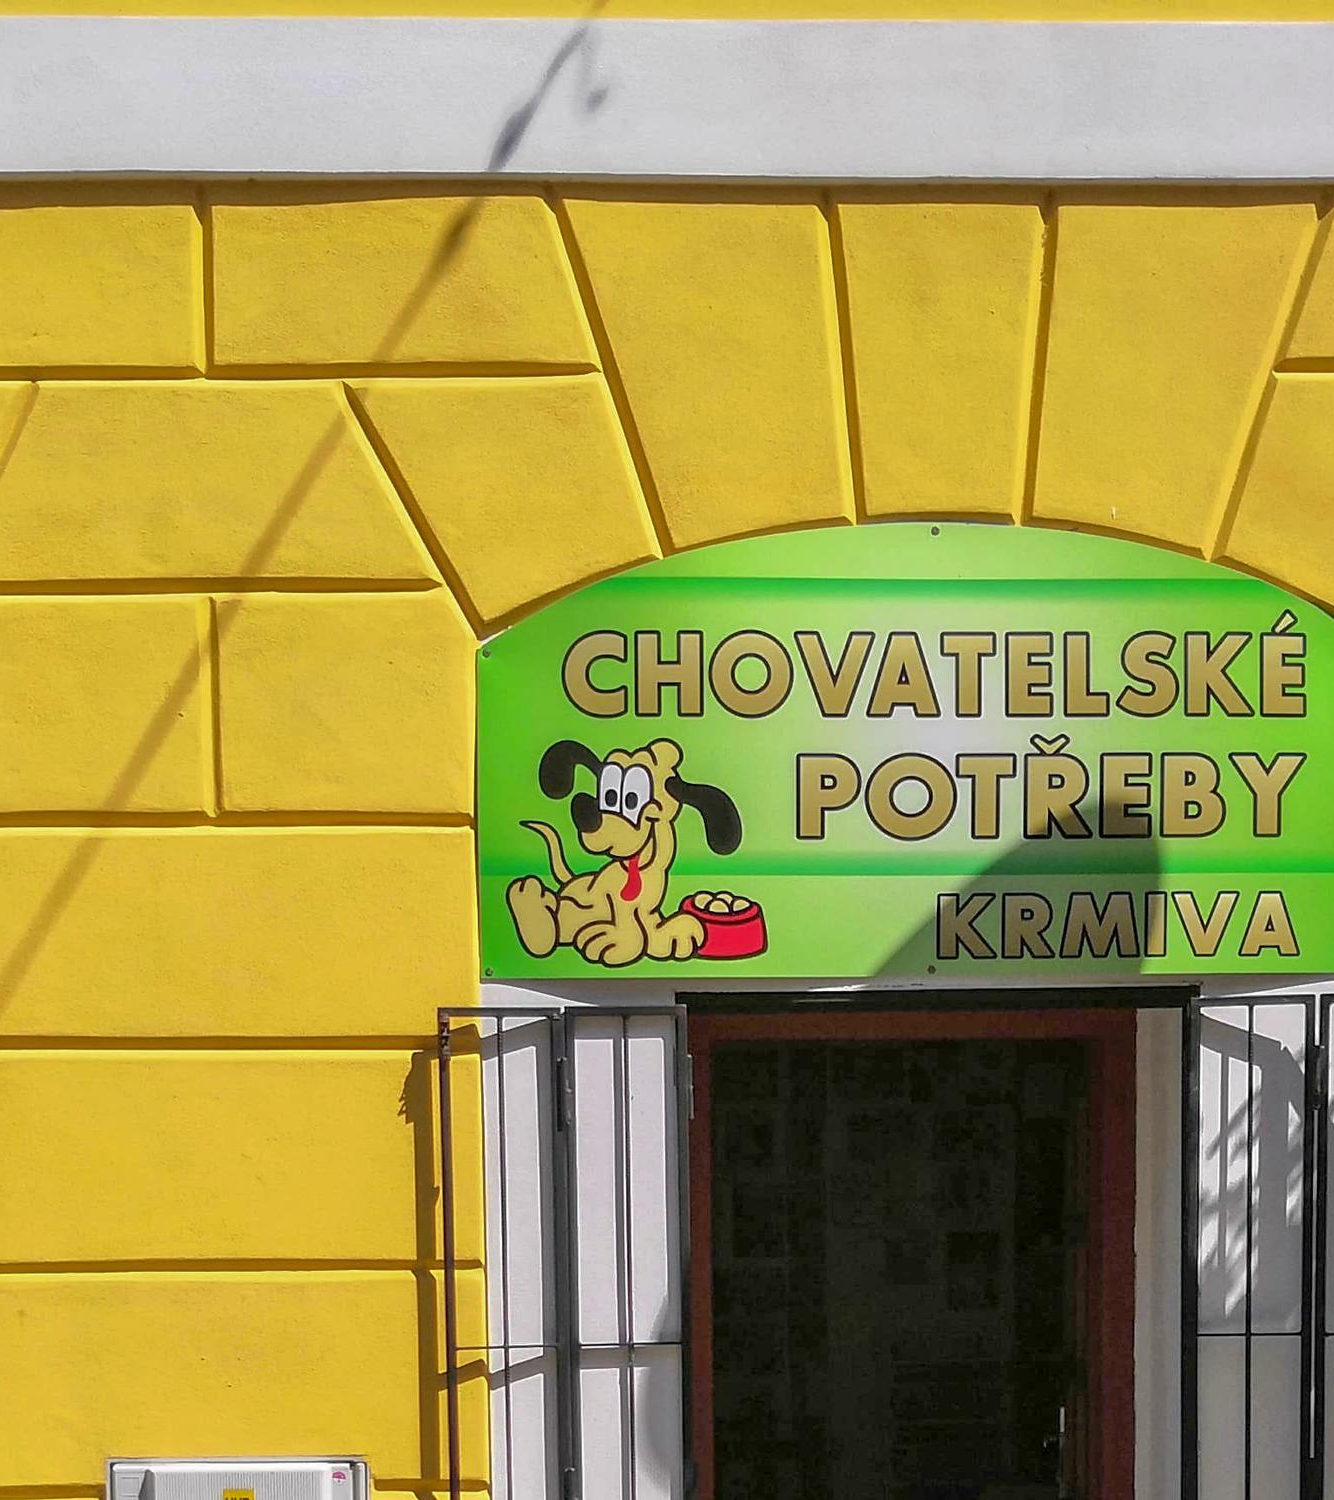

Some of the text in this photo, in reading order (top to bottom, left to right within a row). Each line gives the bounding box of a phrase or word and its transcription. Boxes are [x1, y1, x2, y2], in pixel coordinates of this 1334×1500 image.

[561, 610, 1308, 720] CHOVATELSKÉ
[795, 734, 1308, 842] POTŘEBY
[935, 890, 1300, 961] KRMIVA
